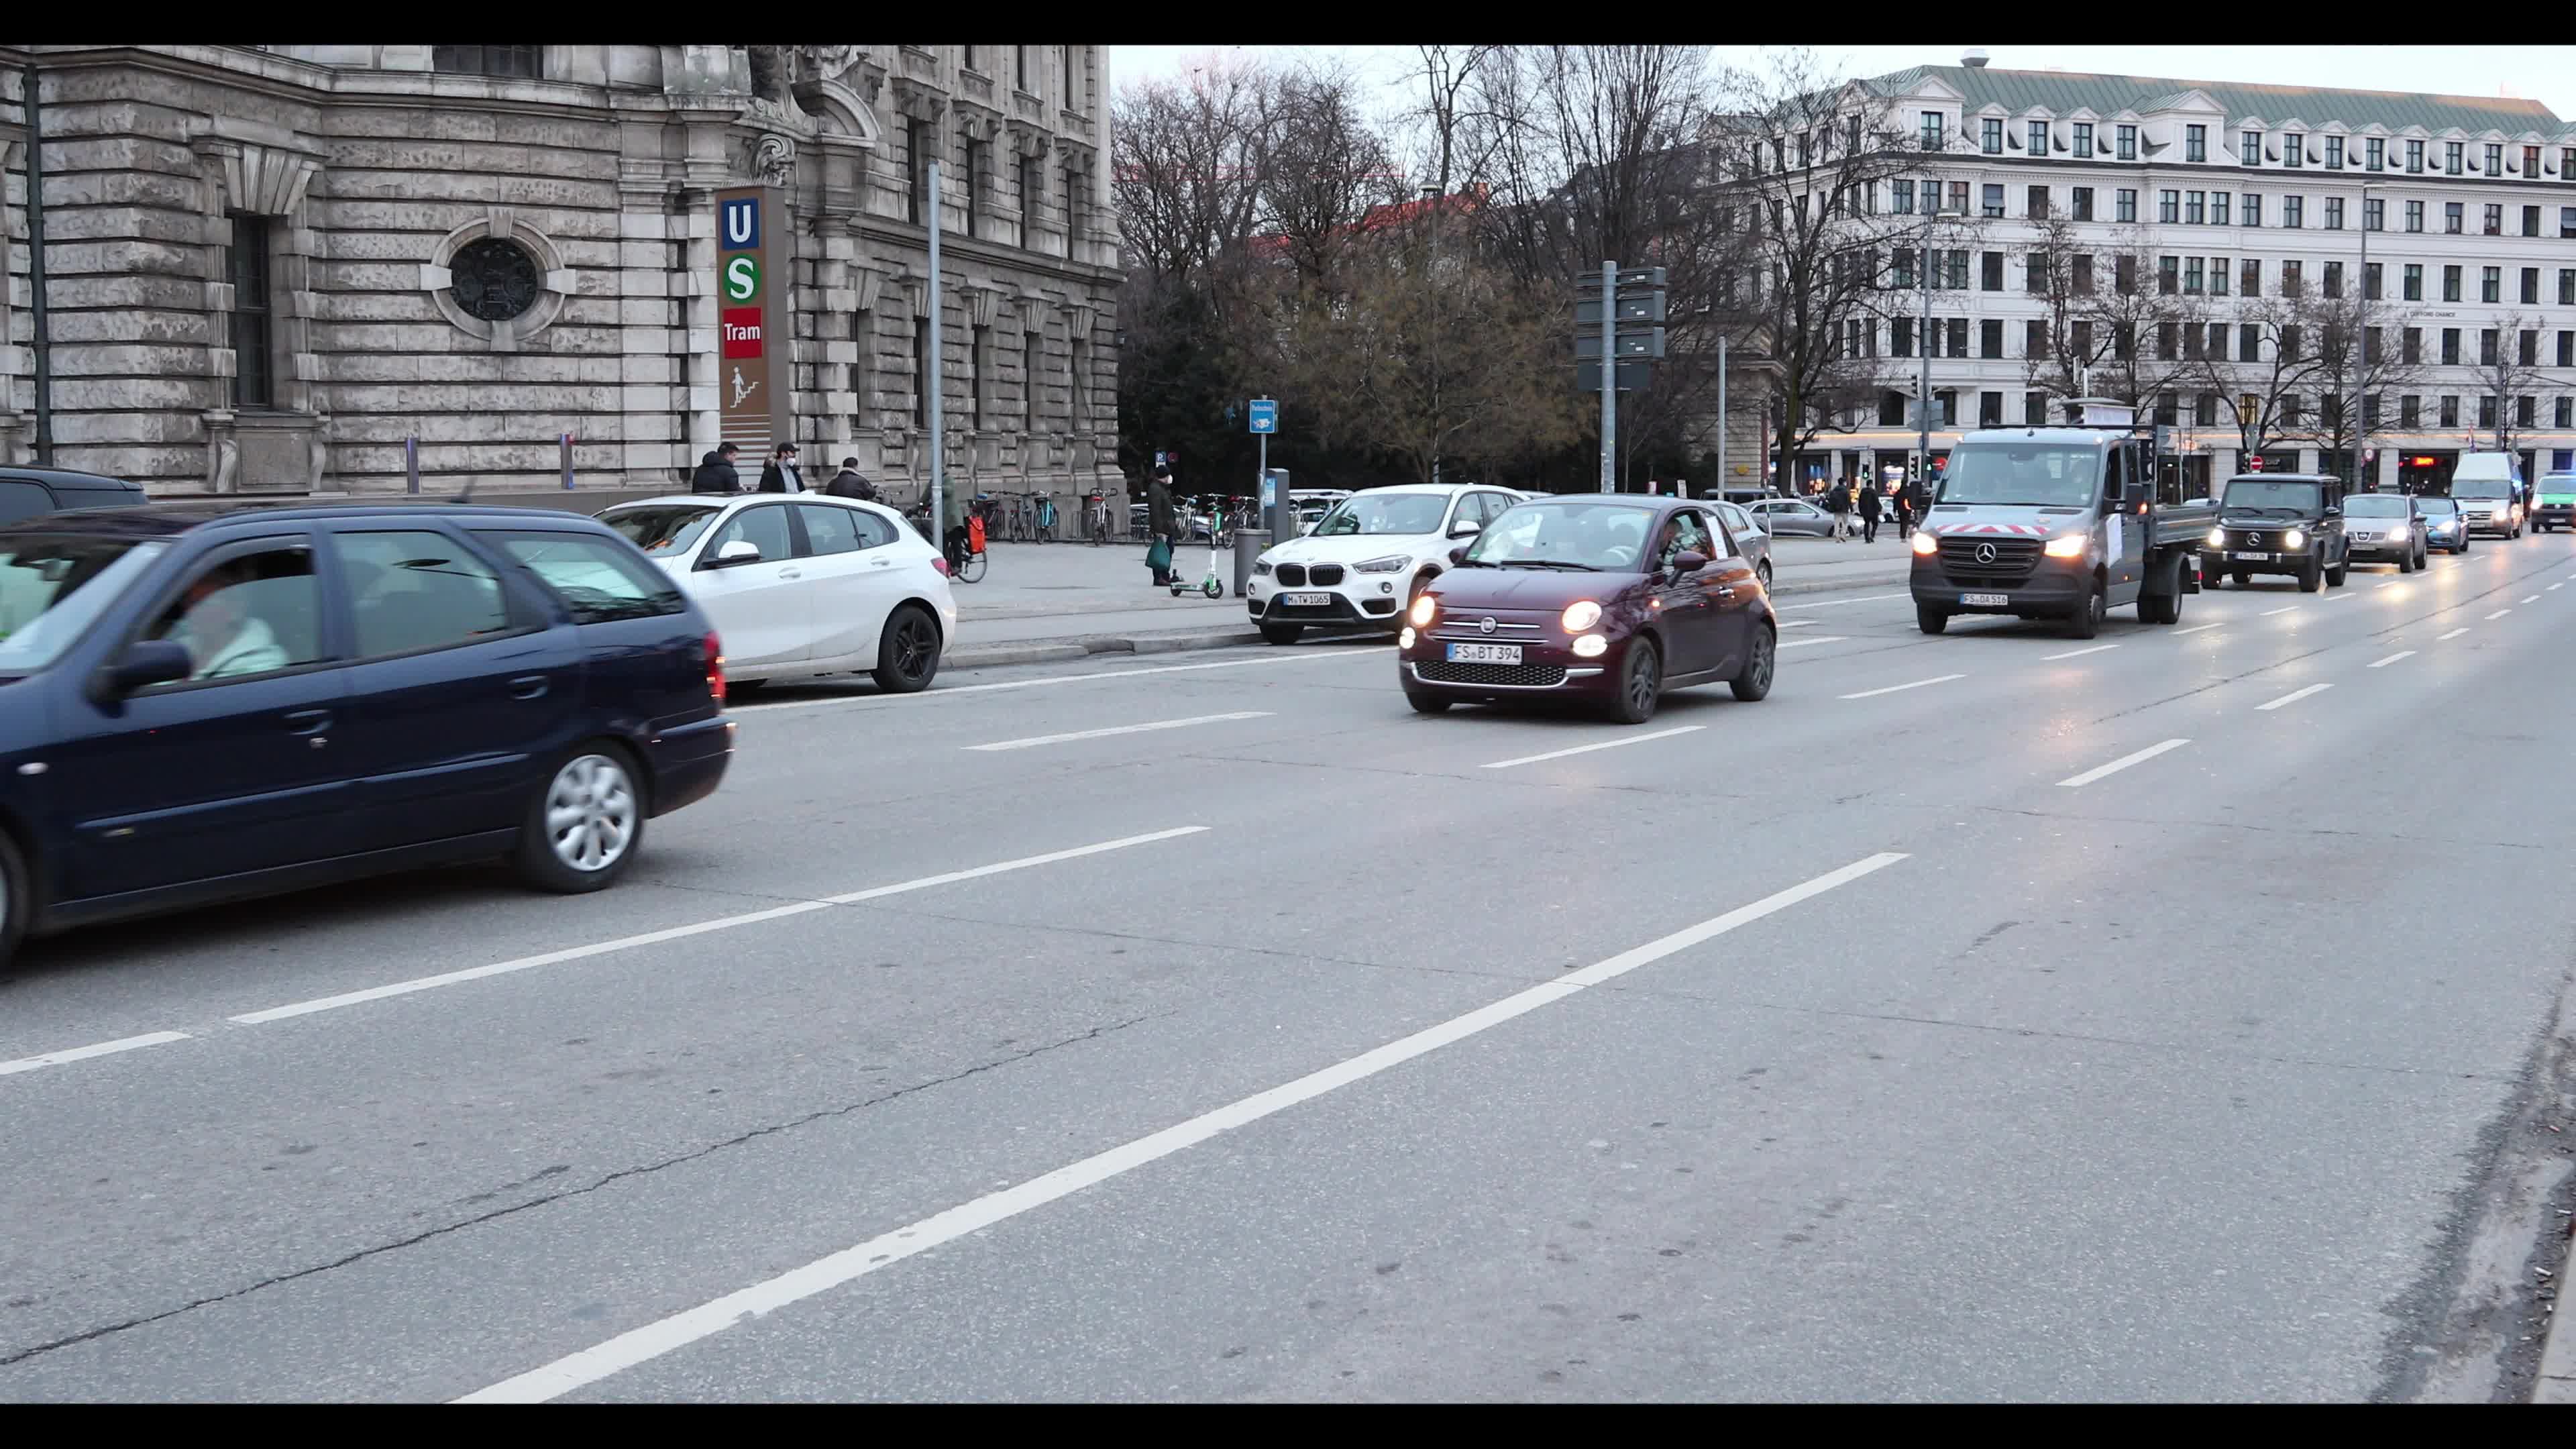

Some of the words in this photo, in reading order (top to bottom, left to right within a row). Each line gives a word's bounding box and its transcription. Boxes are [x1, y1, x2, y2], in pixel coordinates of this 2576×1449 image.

[729, 205, 751, 243] U
[728, 258, 755, 299] S
[724, 323, 761, 341] Tram
[1157, 453, 1163, 462] P
[1309, 596, 1329, 604] 1065
[1454, 645, 1470, 659] FS
[1478, 646, 1495, 659] BT
[1497, 647, 1519, 661] 394
